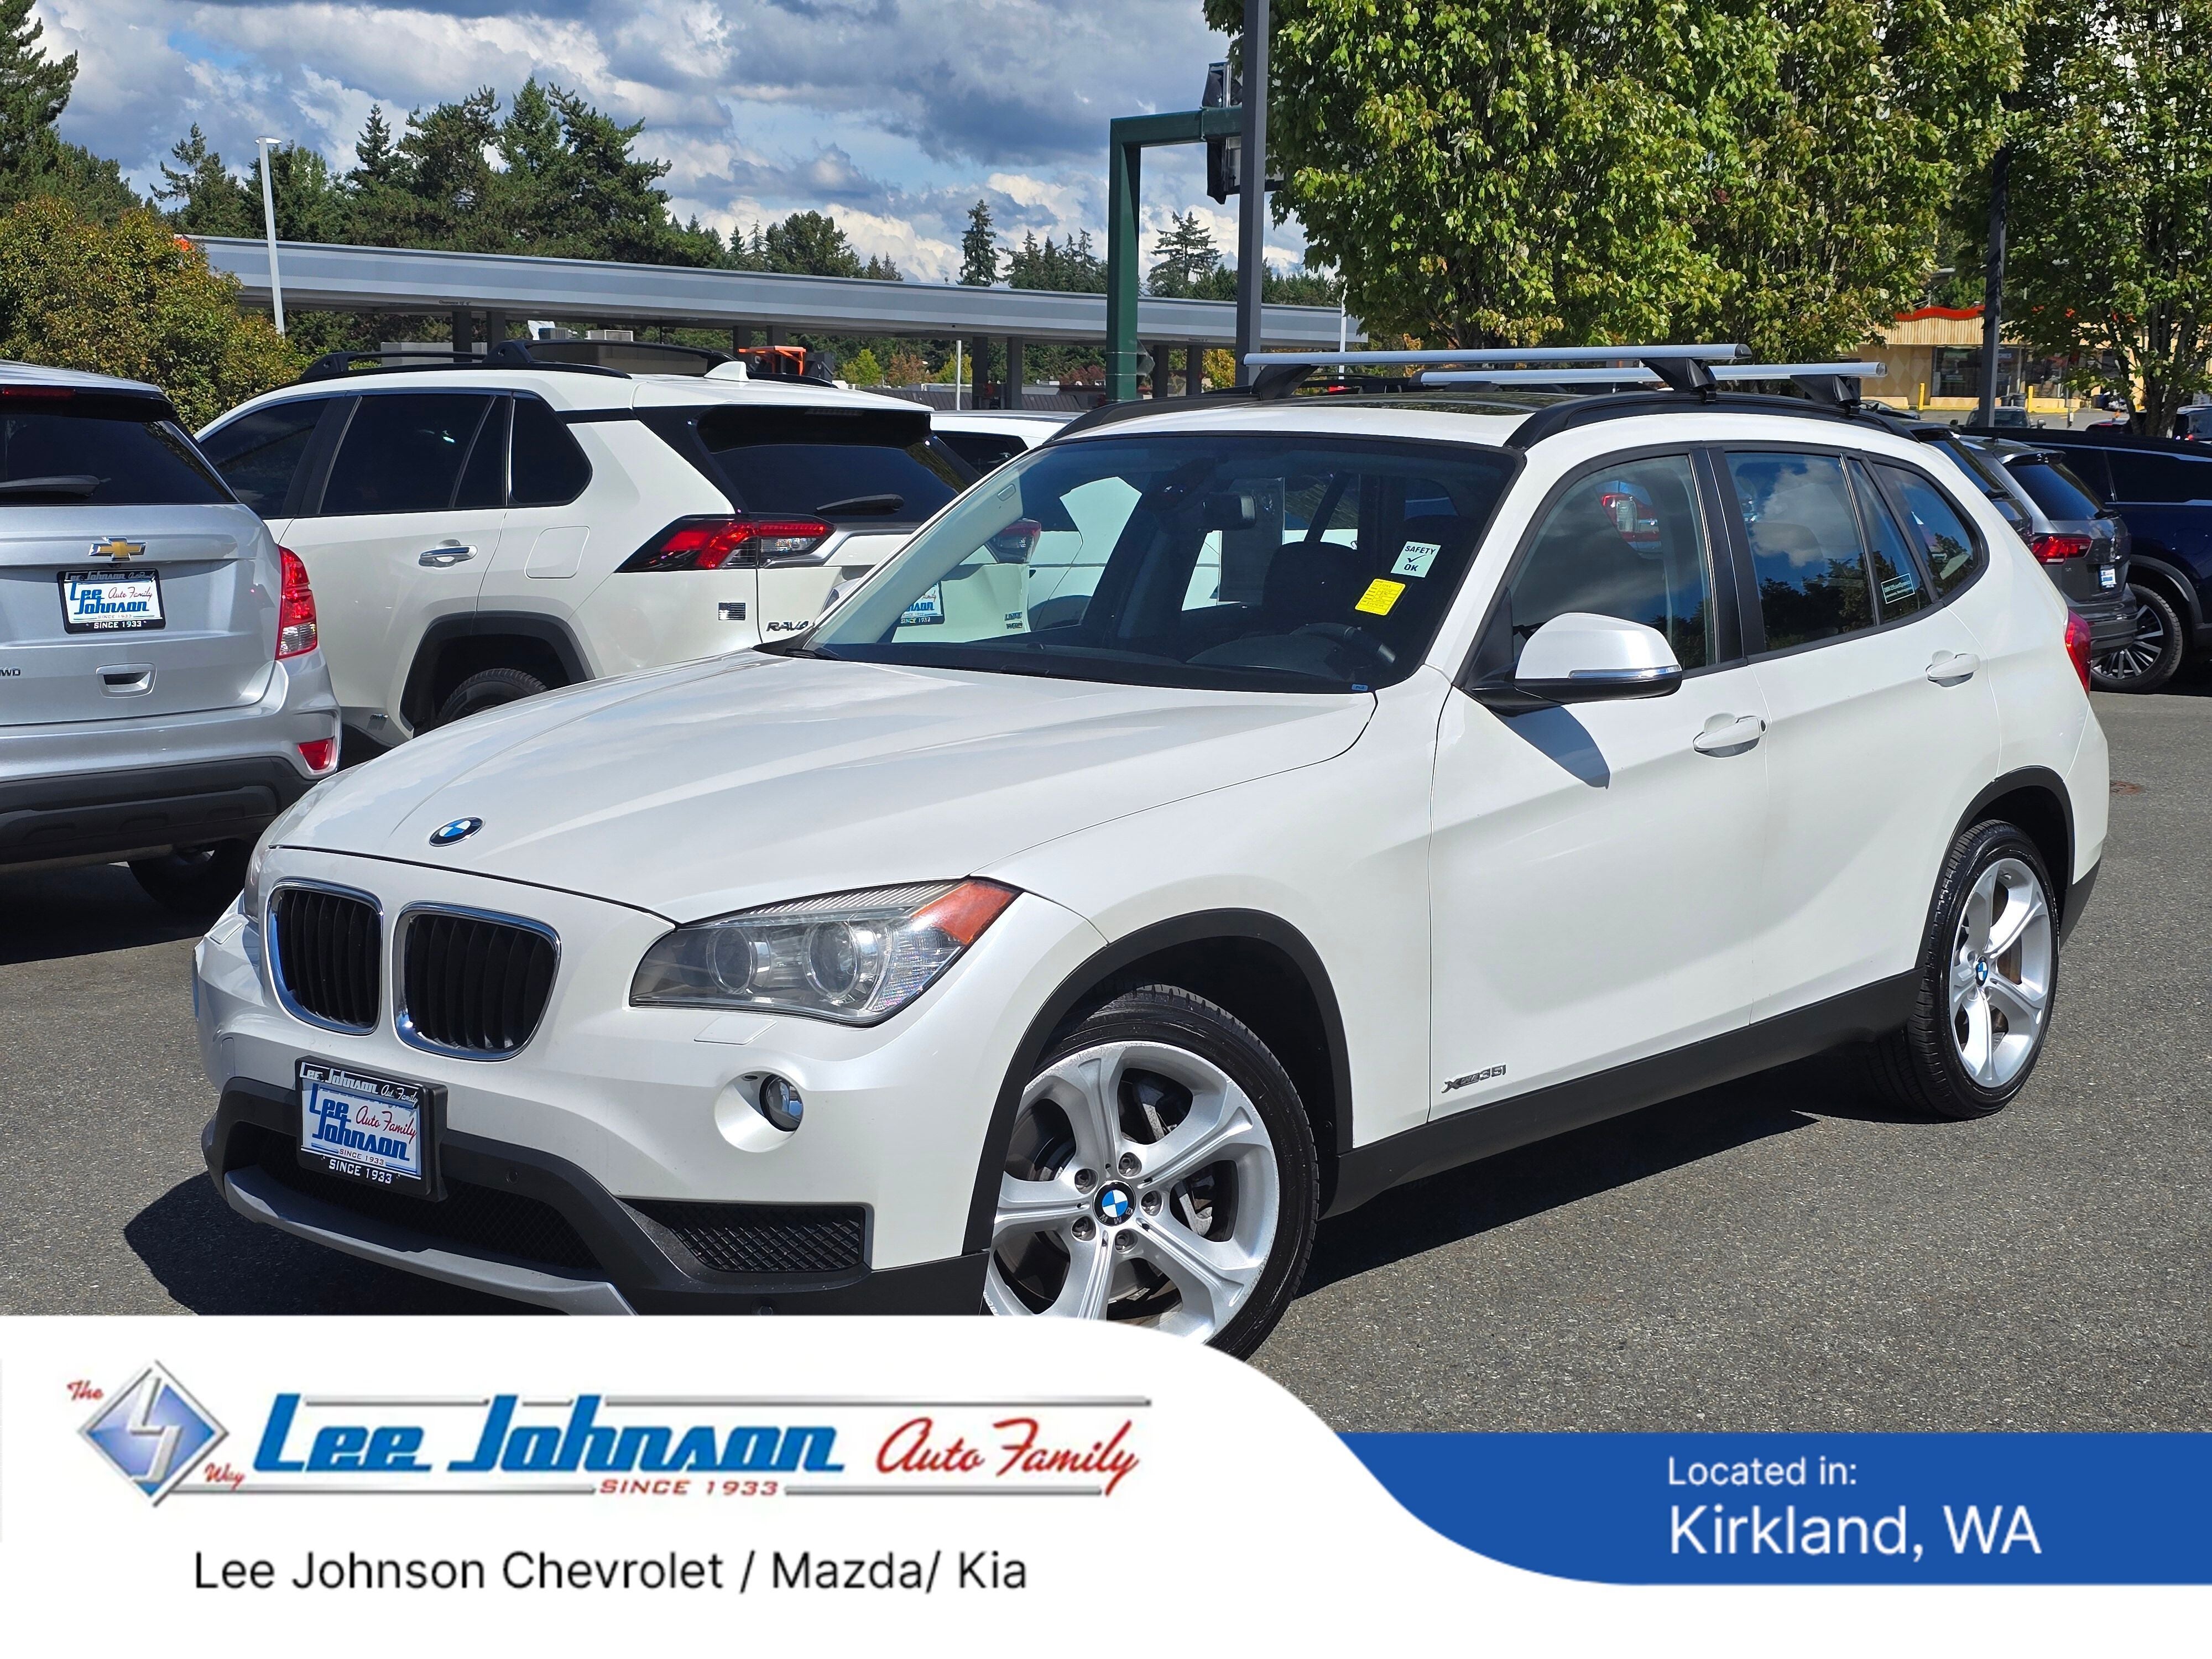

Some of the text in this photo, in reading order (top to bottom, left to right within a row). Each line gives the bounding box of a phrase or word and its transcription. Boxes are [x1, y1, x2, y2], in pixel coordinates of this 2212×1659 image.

[1405, 545, 1436, 555] SAFETY
[84, 571, 126, 581] Johnson
[70, 581, 105, 601] Lee
[108, 586, 153, 602] Auto Family
[74, 596, 150, 614] Johnson
[299, 1062, 324, 1082] Lee
[325, 1068, 379, 1094] Johnson
[397, 1087, 419, 1107] Family
[309, 1083, 352, 1123] Lee
[356, 1105, 418, 1144] Auto Family
[312, 1115, 410, 1161] Johnson
[339, 1149, 385, 1166] SINCE 1933
[328, 1159, 392, 1184] SINCE 1933
